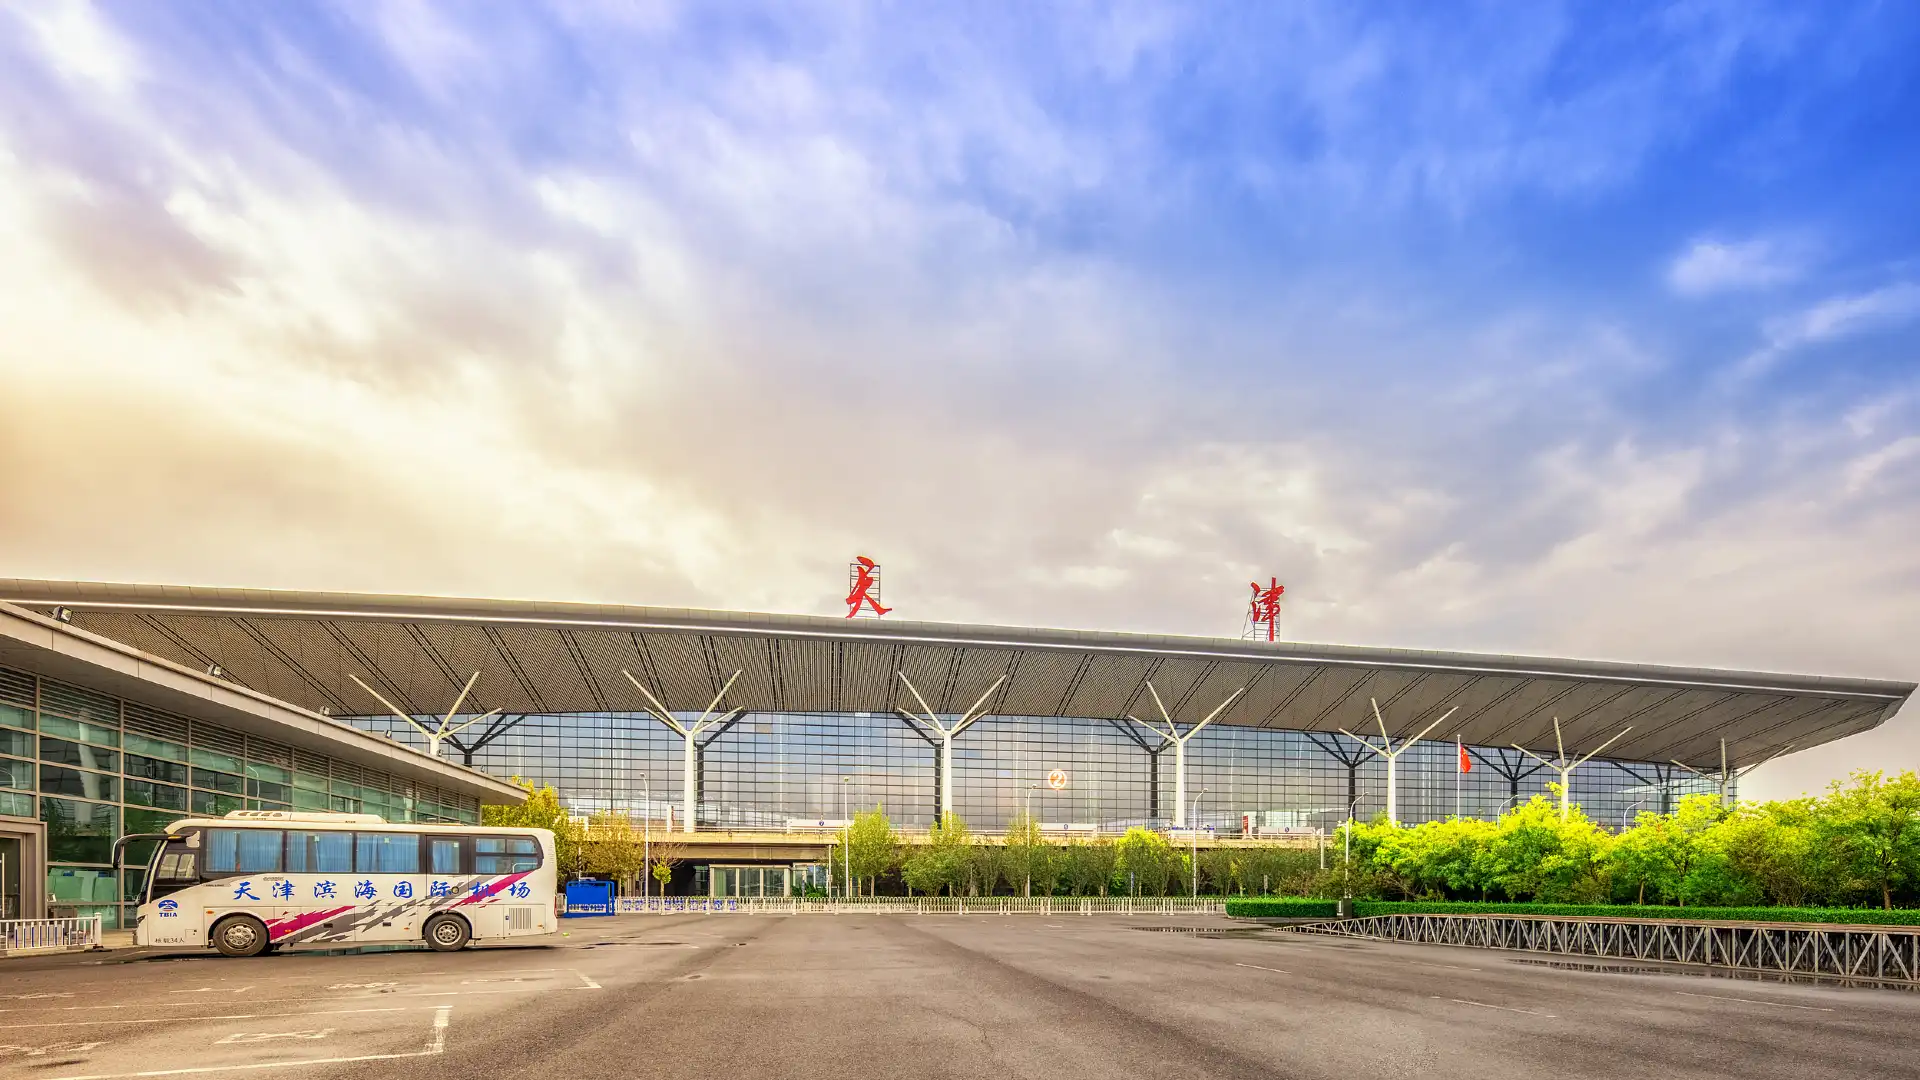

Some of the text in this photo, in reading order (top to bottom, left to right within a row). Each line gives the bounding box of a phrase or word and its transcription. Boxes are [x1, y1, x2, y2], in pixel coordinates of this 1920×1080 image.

[846, 556, 1284, 641] 天 津
[233, 879, 531, 901] 天津滨海国际机场
